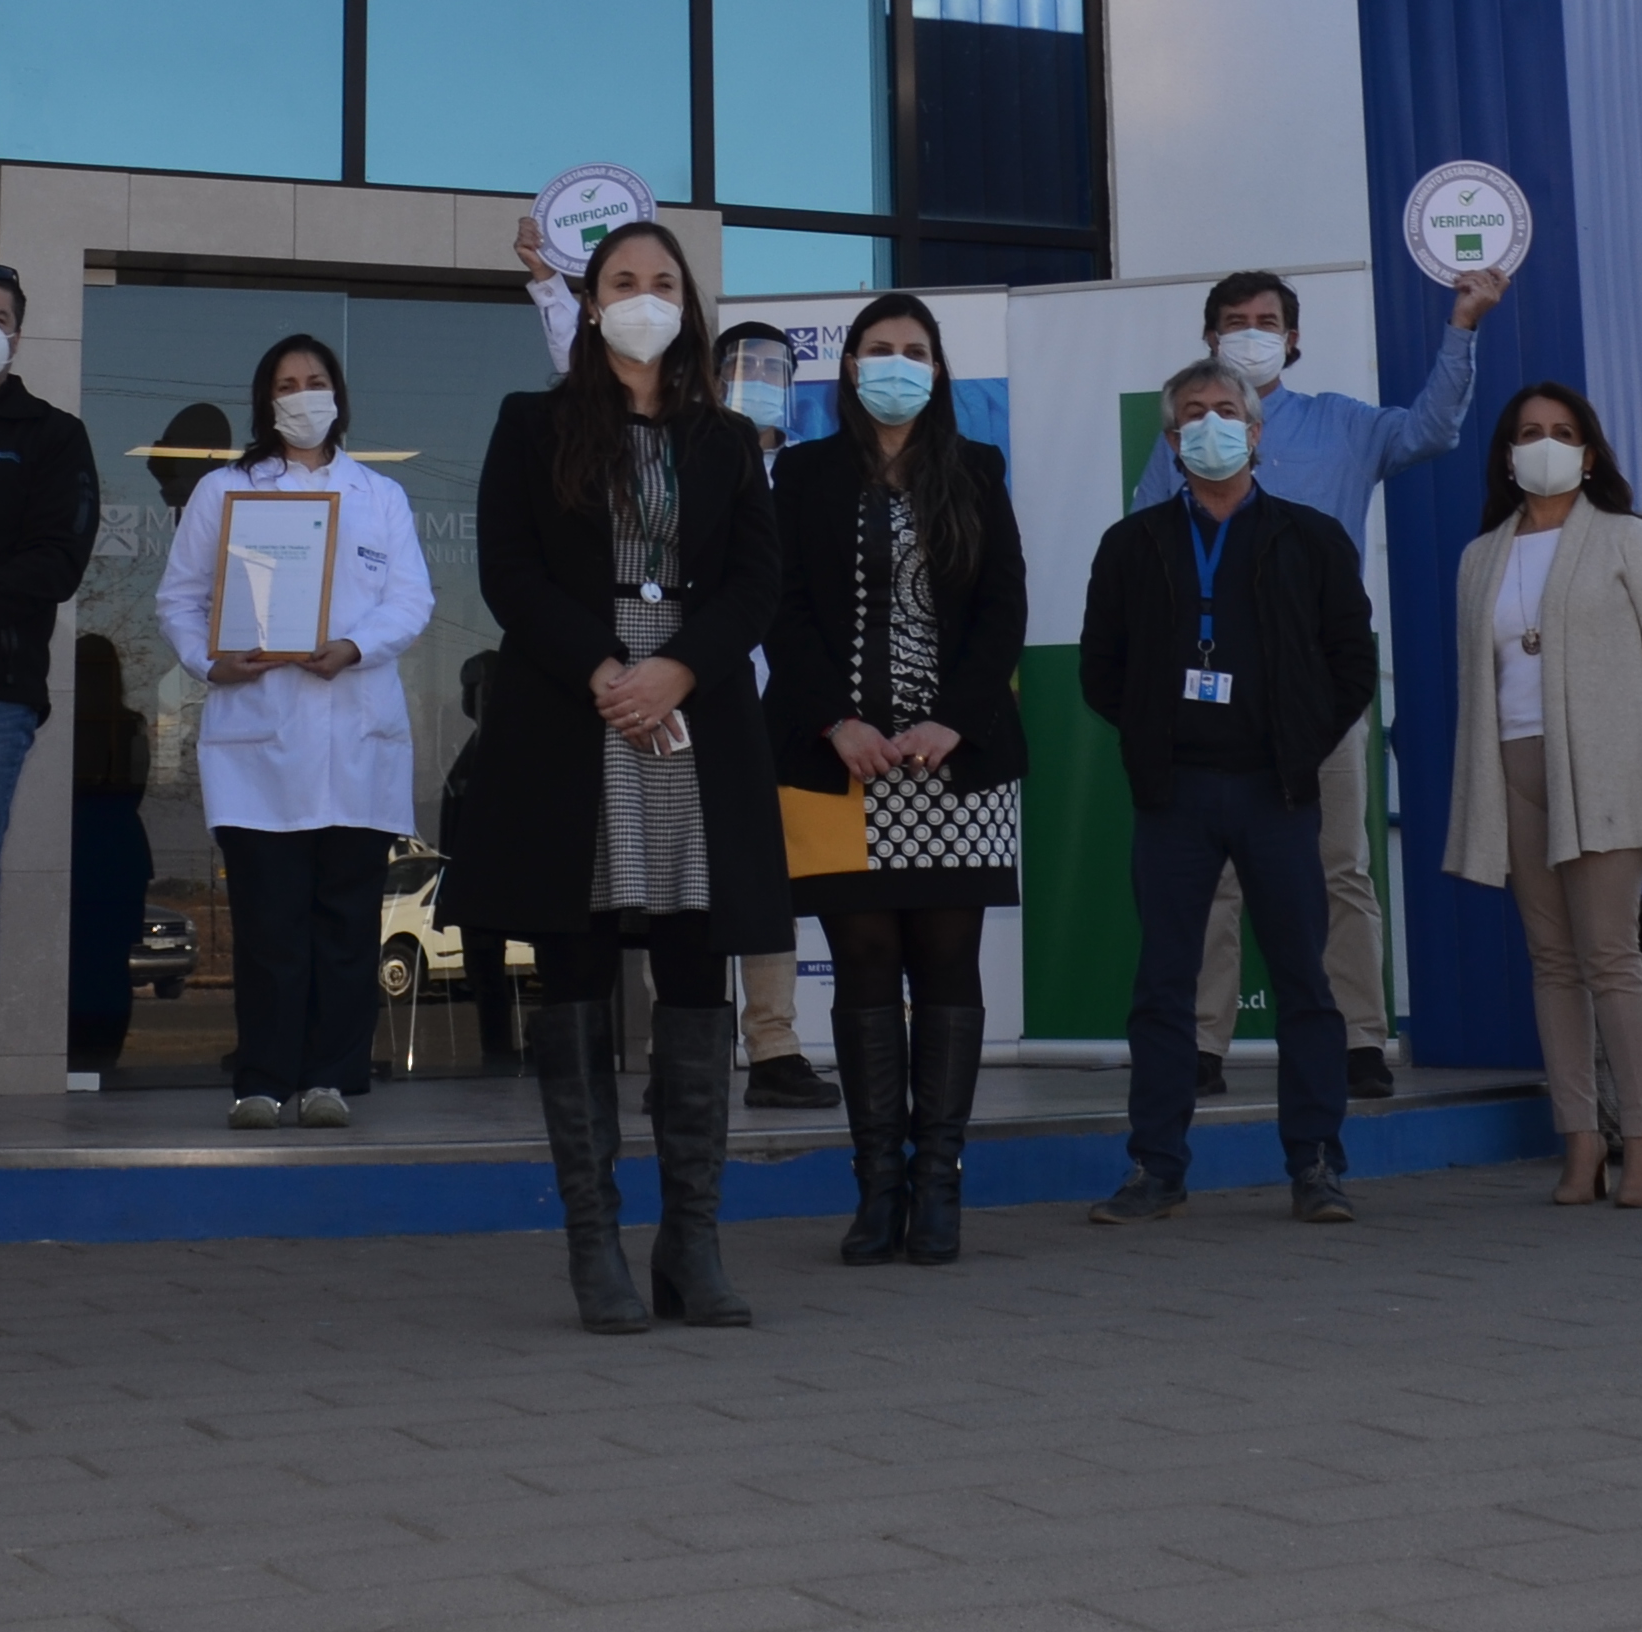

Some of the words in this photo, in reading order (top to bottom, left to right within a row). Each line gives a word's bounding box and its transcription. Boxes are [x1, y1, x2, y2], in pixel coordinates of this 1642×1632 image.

[554, 201, 629, 229] VERIFICADO
[1430, 213, 1505, 228] VERIFICADO
[567, 261, 587, 272] PAS
[1439, 268, 1458, 282] PAS
[1498, 243, 1523, 272] ABORAL
[807, 963, 832, 972] MÉTO
[1237, 989, 1266, 1009] s.cl
